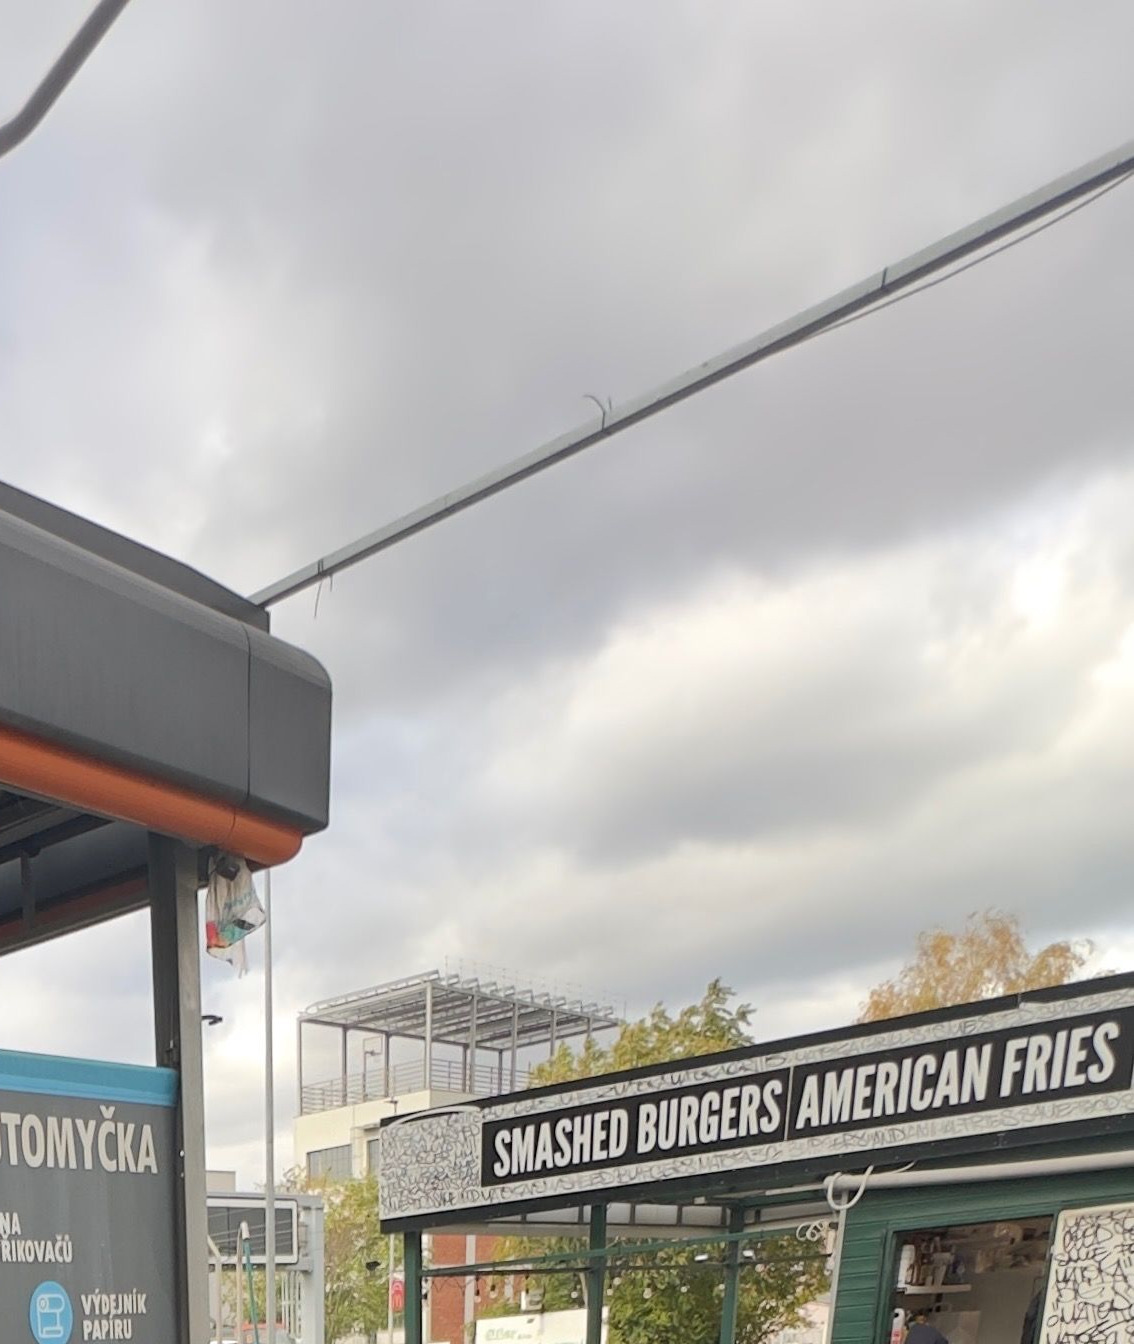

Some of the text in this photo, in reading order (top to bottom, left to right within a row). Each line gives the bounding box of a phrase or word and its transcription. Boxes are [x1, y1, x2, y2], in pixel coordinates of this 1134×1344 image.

[493, 1110, 629, 1178] SMASHED
[637, 1079, 783, 1155] BURGERS
[795, 1042, 994, 1131] AMERICAN
[1000, 1021, 1120, 1098] FRIES
[81, 1288, 147, 1316] VÝDEJNÍK
[82, 1316, 133, 1341] PAPÍRU
